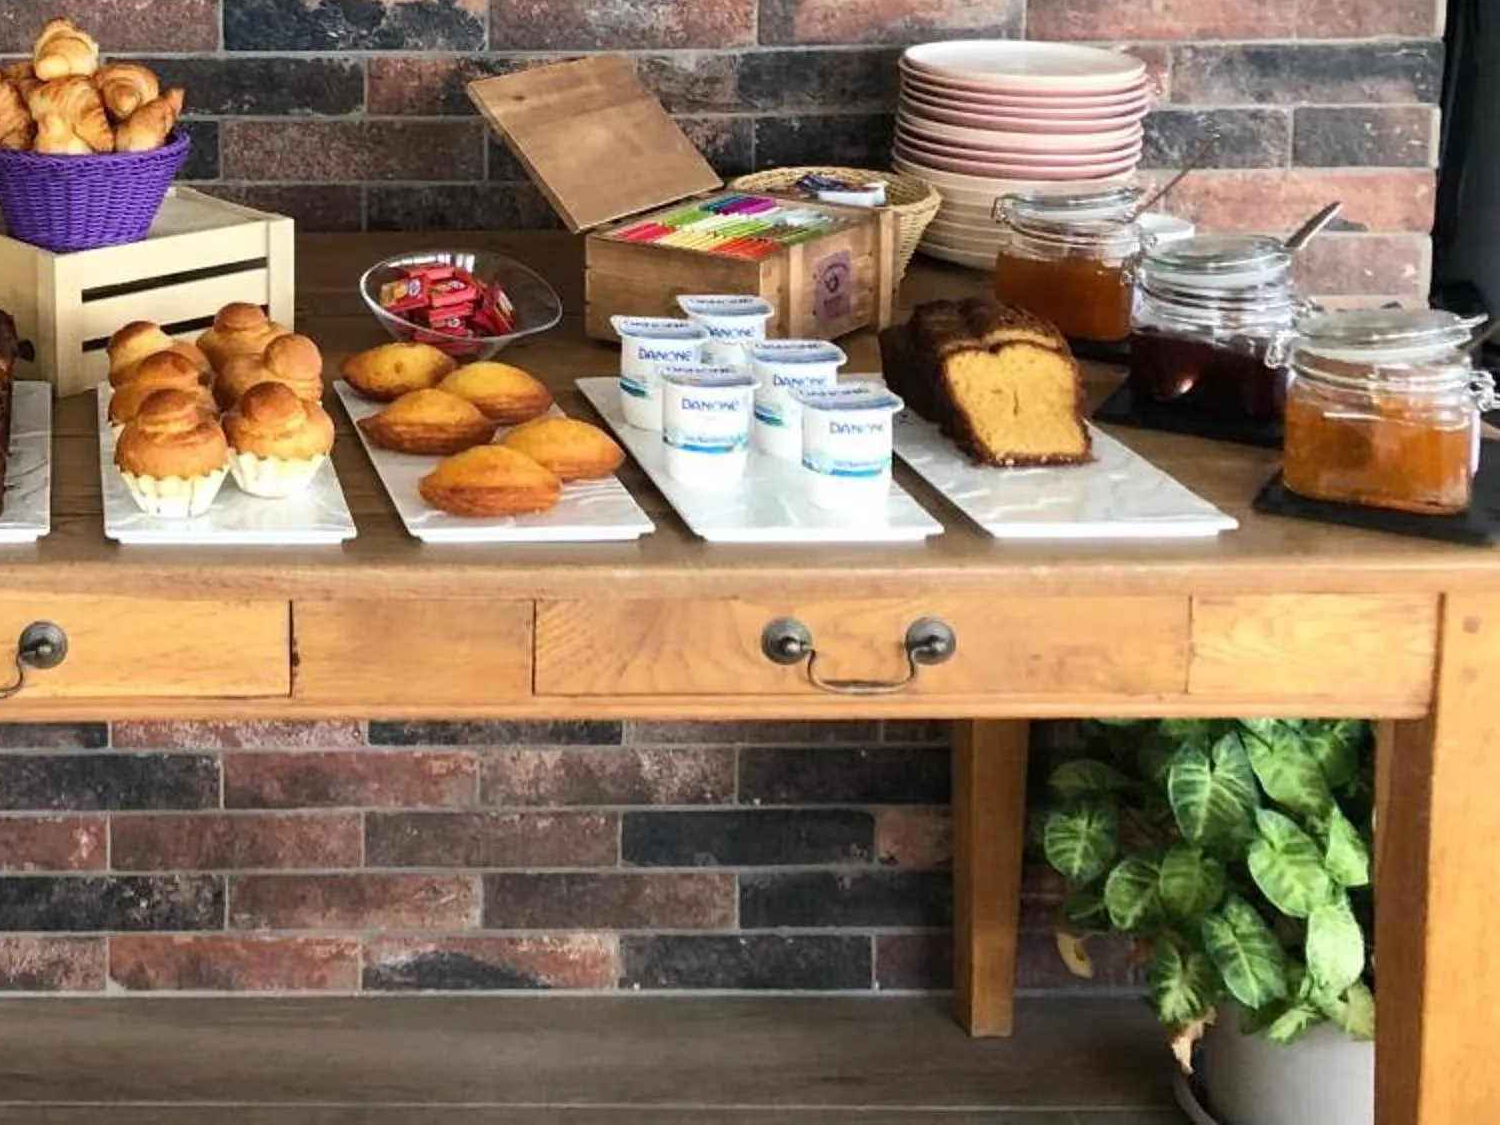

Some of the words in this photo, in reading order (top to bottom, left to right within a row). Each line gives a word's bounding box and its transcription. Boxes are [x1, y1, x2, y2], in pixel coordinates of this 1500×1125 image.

[638, 347, 692, 361] DANONE
[772, 374, 826, 387] DANONE
[681, 397, 740, 409] DANONE
